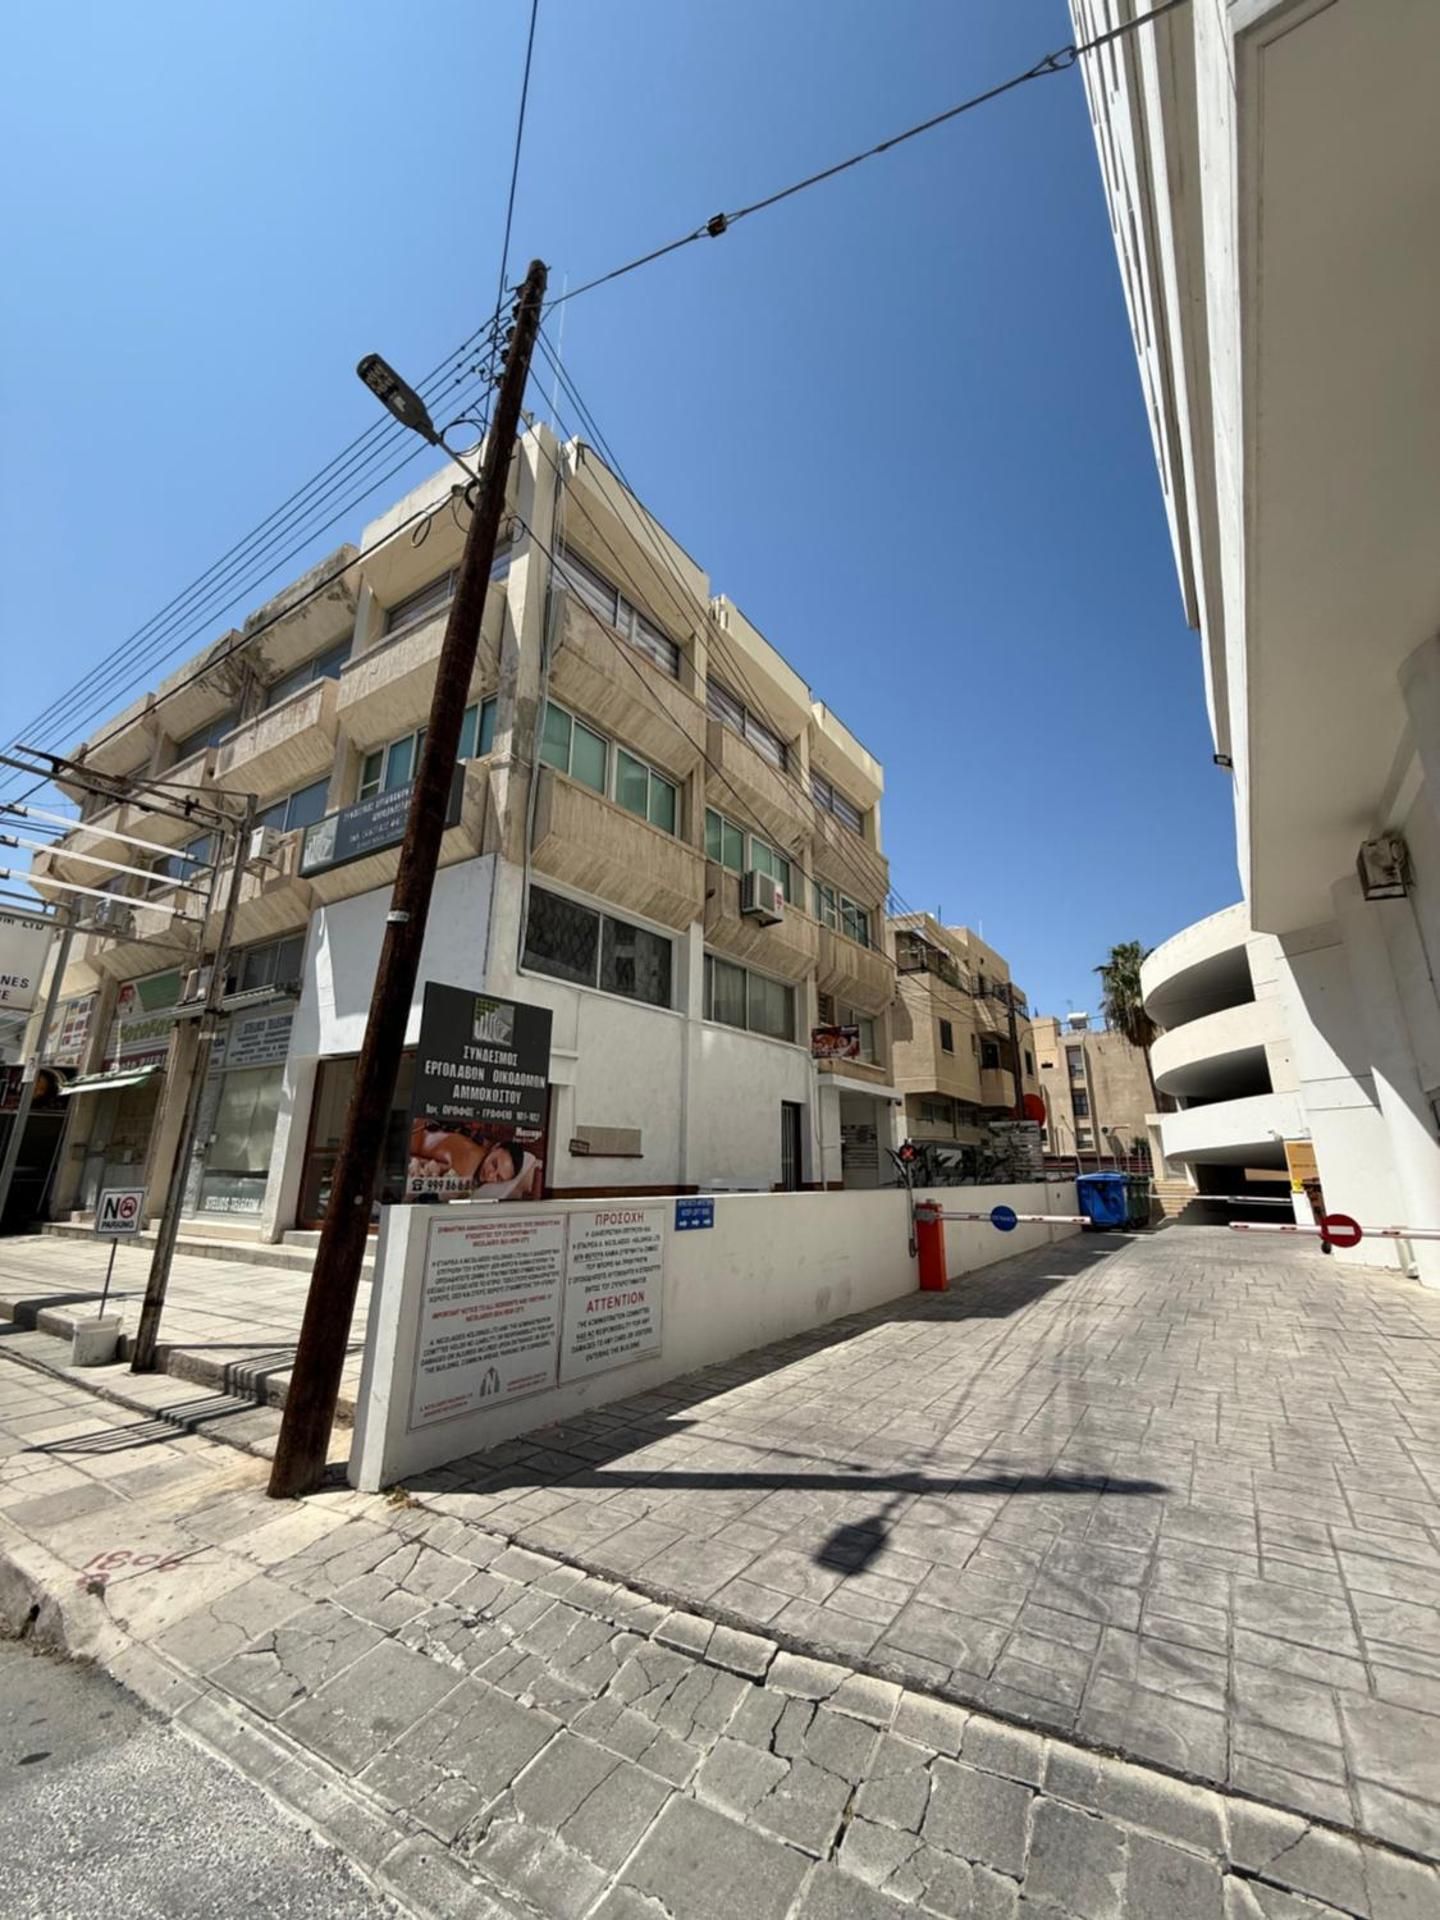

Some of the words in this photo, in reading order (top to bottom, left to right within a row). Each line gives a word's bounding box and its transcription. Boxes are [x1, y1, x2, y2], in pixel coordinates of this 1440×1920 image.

[463, 1045, 518, 1067] ΣΥΝΔΕΣΜΟΣ
[425, 1060, 485, 1081] ΕΡΓΟΛΑΒΩΝ
[493, 1070, 546, 1089] ΟΙΚΟΔΟΜΩΝ
[452, 1084, 522, 1105] ΑΜΜΟΧΩΣΤΟΥ
[102, 1220, 134, 1230] PARKING
[595, 1212, 644, 1226] ΠΡΟΣΟΧΗ
[586, 1290, 645, 1313] ATTENTION
